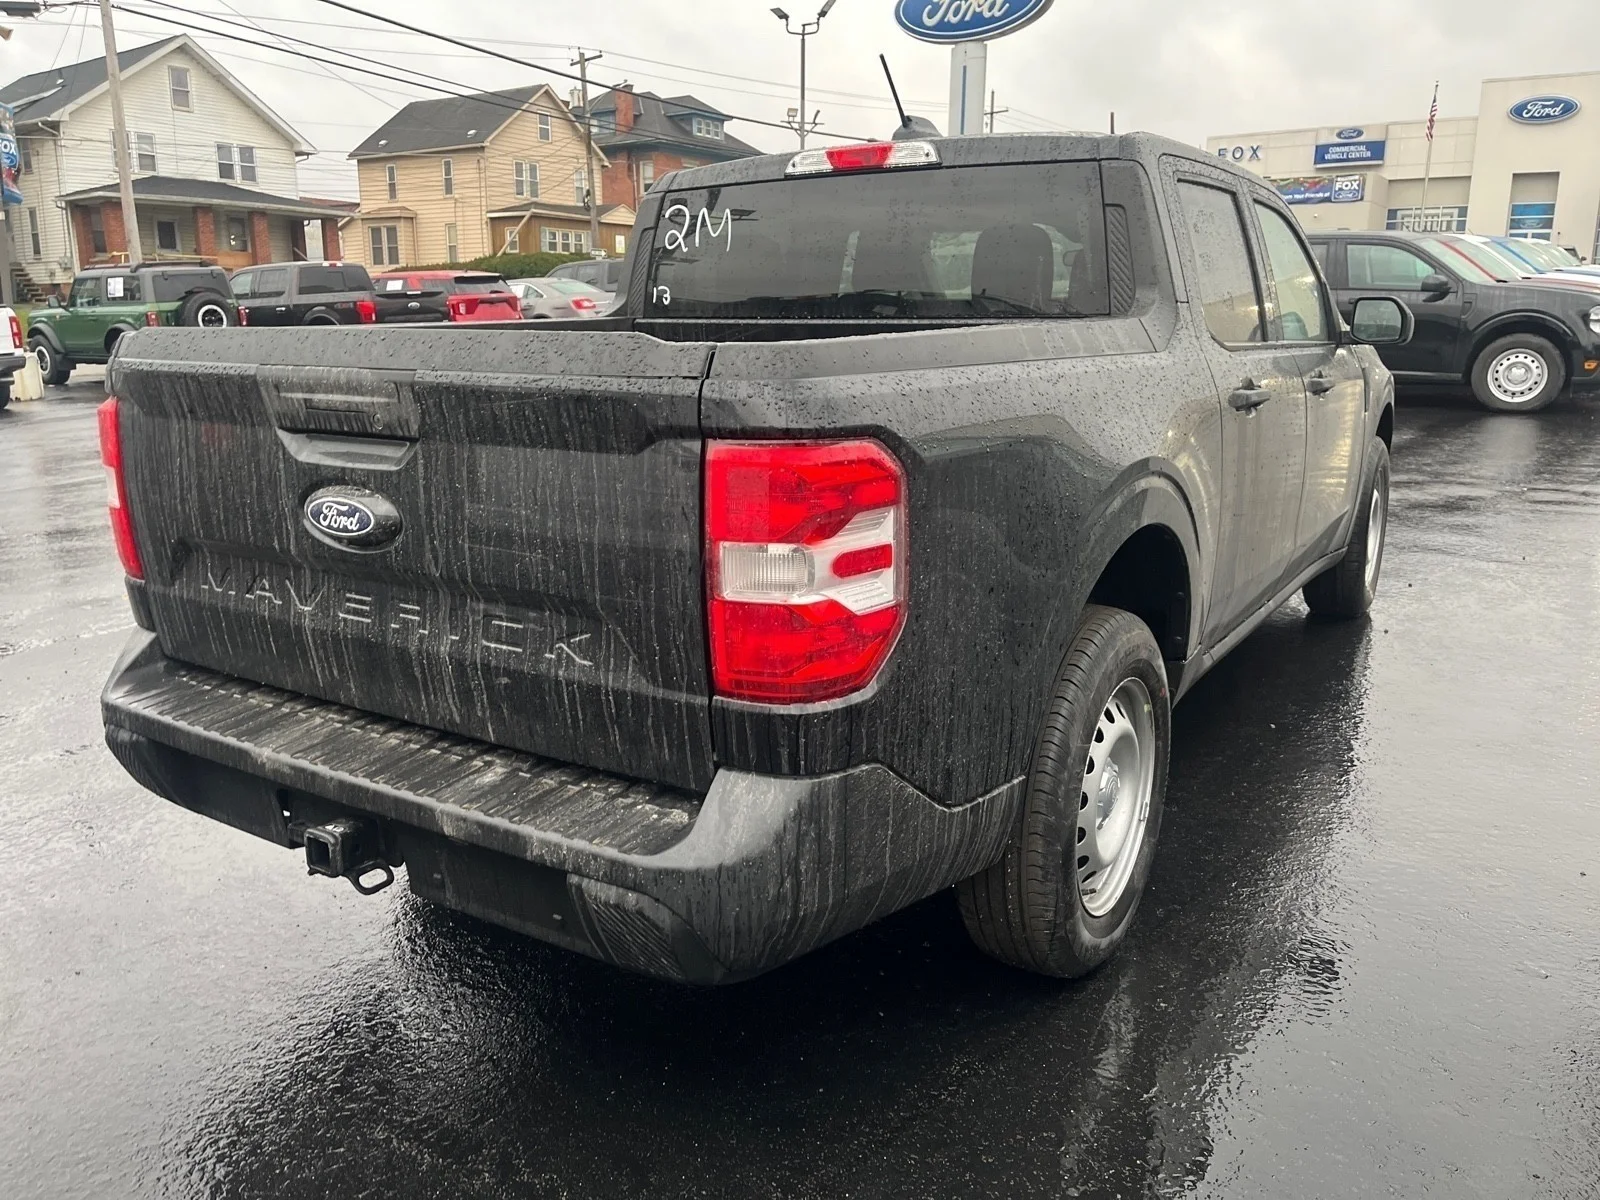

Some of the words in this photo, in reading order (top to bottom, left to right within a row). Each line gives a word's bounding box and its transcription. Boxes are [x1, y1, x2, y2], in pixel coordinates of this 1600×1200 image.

[922, 0, 1010, 27] Ford
[1522, 100, 1565, 118] Ford
[0, 140, 16, 156] OX
[1324, 152, 1347, 160] VEHICLE
[1348, 151, 1371, 159] CENTER
[1328, 145, 1367, 153] COMMERCIAL
[1335, 181, 1359, 191] FOX
[652, 286, 671, 305] 13
[320, 502, 360, 531] Ford
[201, 562, 594, 667] MAVERICK
